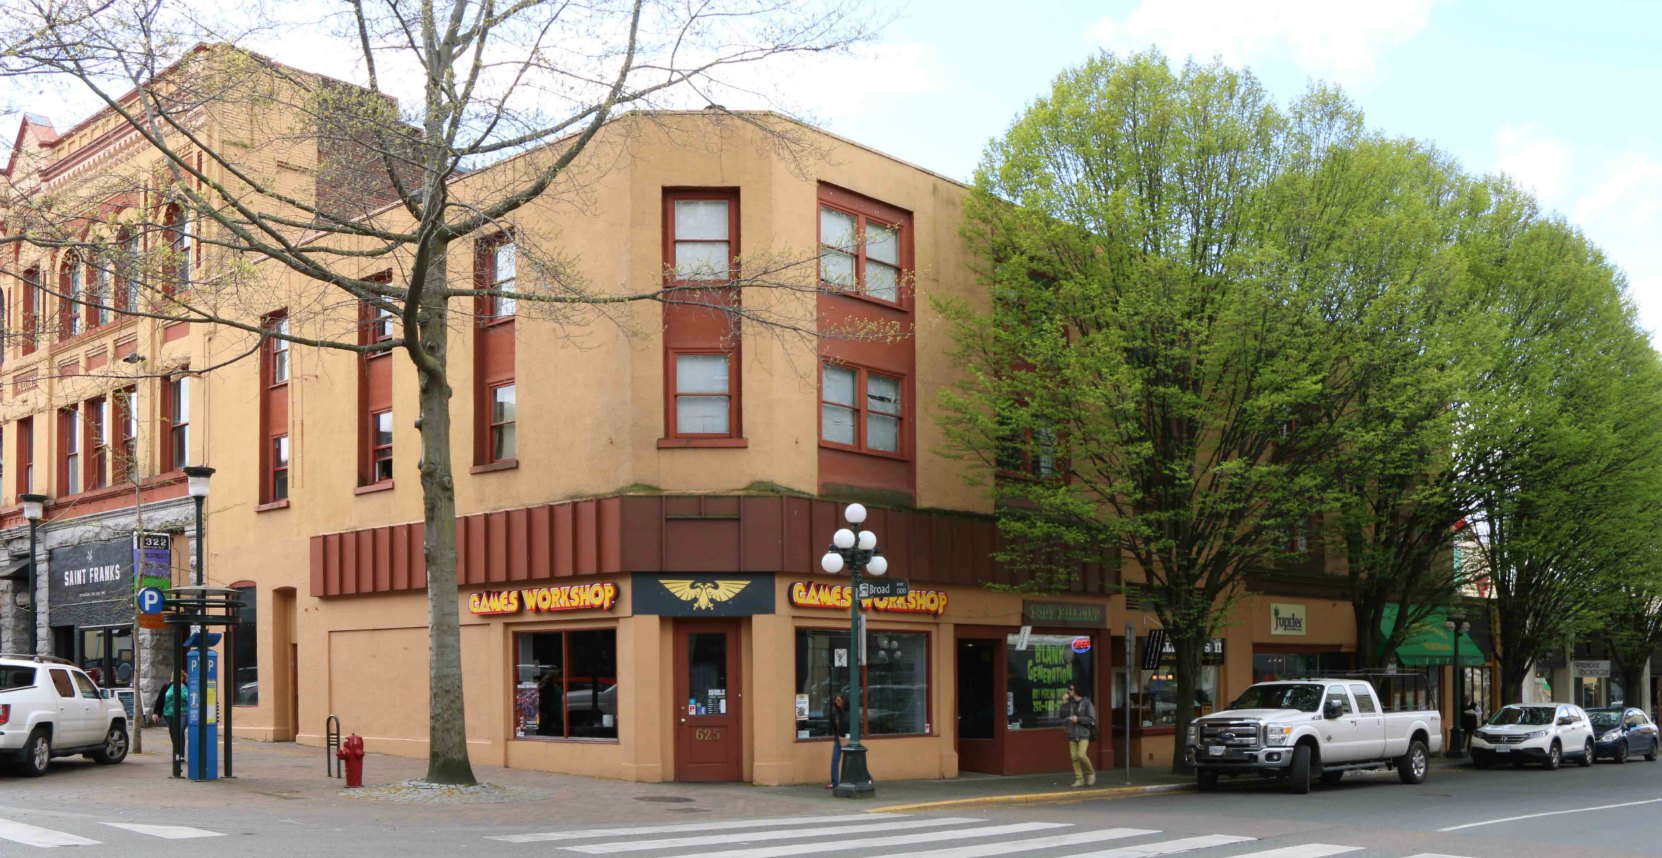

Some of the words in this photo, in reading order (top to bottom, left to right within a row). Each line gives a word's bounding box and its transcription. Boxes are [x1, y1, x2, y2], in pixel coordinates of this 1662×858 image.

[64, 568, 86, 587] SAINT
[89, 563, 120, 583] FRANKS
[469, 591, 519, 615] GAMES
[521, 582, 616, 612] WORKSHOP
[792, 581, 852, 607] GAMES
[869, 583, 890, 595] Broad
[144, 591, 158, 611] P
[1035, 643, 1065, 665] BLANK
[191, 660, 197, 672] P
[208, 660, 214, 672] P
[1027, 659, 1073, 685] GENERATION
[695, 728, 720, 741] 625
